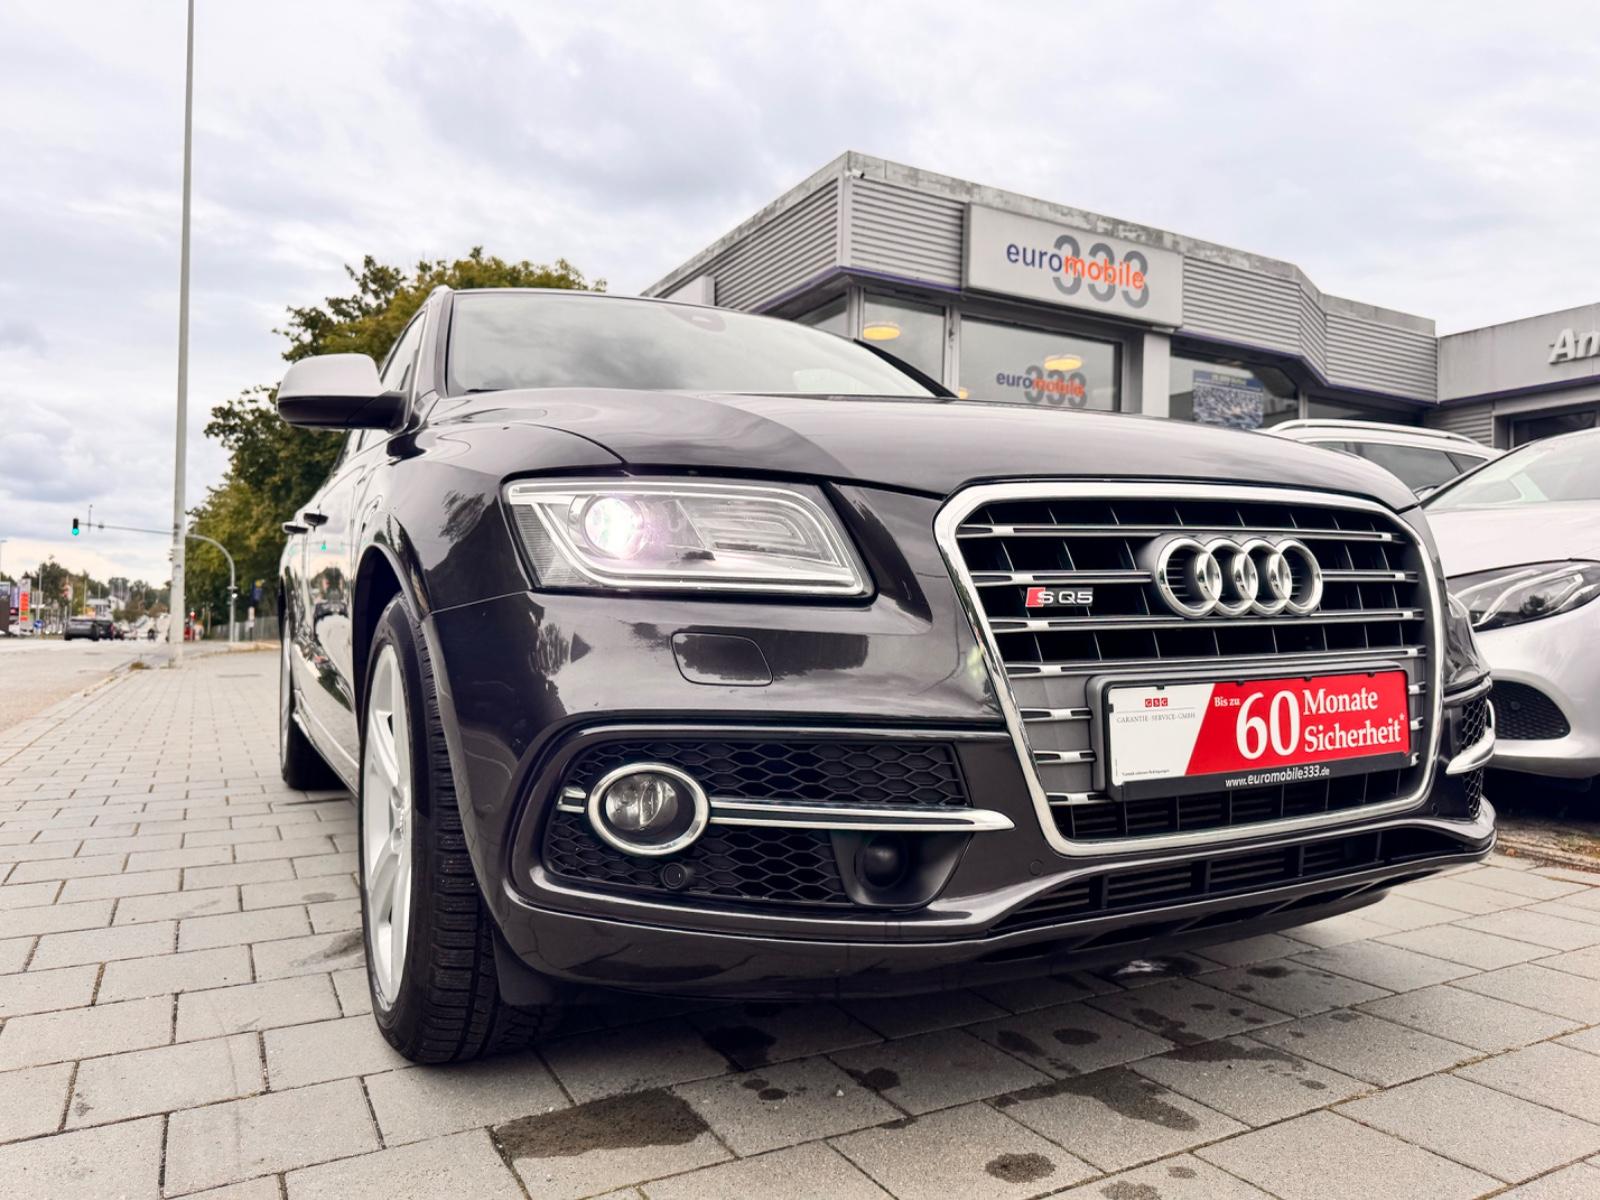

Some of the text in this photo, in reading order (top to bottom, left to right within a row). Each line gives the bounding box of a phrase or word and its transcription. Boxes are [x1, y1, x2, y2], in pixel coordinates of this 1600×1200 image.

[1006, 243, 1145, 290] euromobile
[1052, 234, 1149, 309] 333
[996, 371, 1085, 397] euromobile
[1034, 589, 1094, 605] SQ5
[1302, 687, 1378, 716] Monate
[1214, 689, 1301, 761] Bis zu 60
[1225, 765, 1330, 788] www.euromobile333.de
